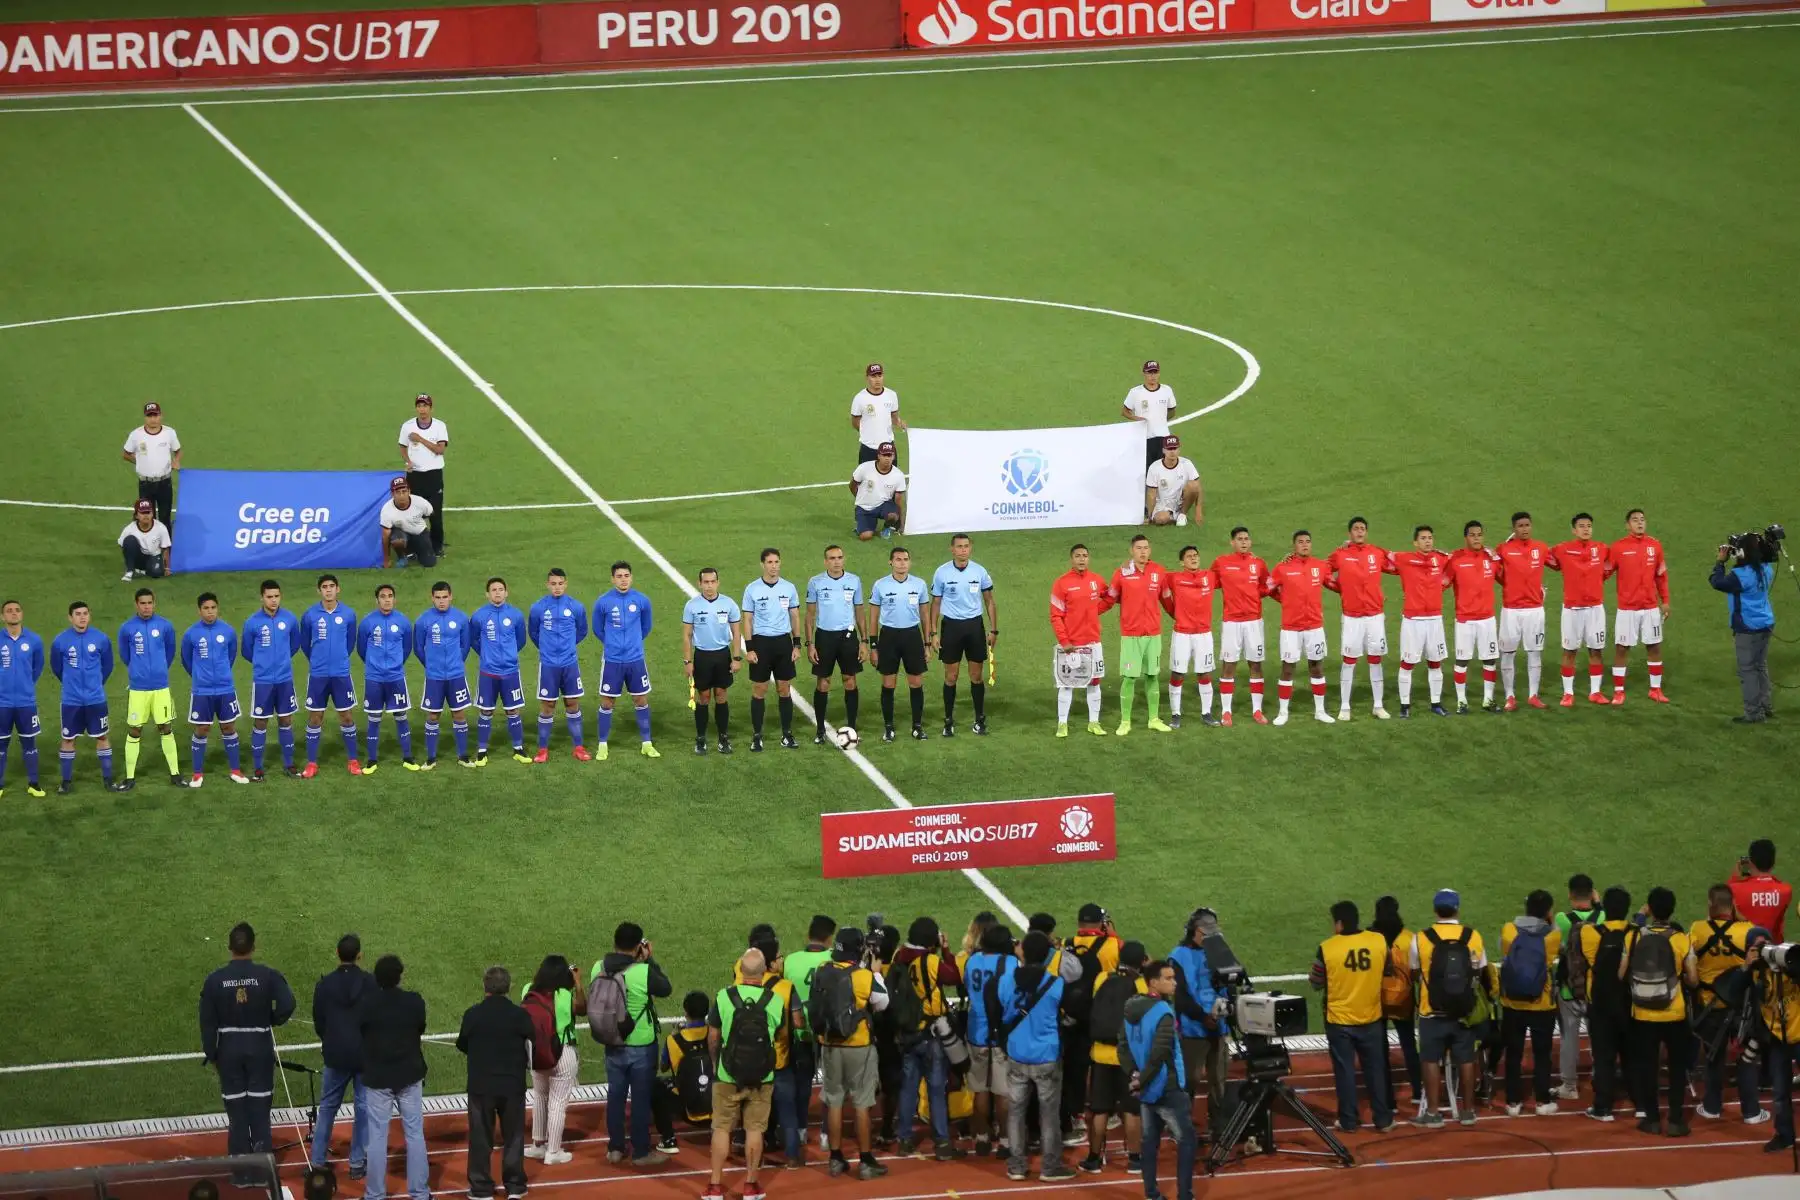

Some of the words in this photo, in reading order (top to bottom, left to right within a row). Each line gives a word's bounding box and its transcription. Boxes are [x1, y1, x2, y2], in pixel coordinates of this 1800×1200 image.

[597, 5, 718, 49] PERU
[731, 2, 841, 44] 2019
[987, 0, 1236, 42] Santander
[238, 502, 295, 523] Cree
[300, 507, 330, 523] en
[234, 523, 328, 549] grande.
[393, 693, 405, 705] 14
[455, 690, 468, 703] 22
[912, 850, 941, 864] PERÚ
[943, 850, 969, 862] 2019
[1751, 889, 1780, 907] PERÚ
[1344, 948, 1371, 972] 46
